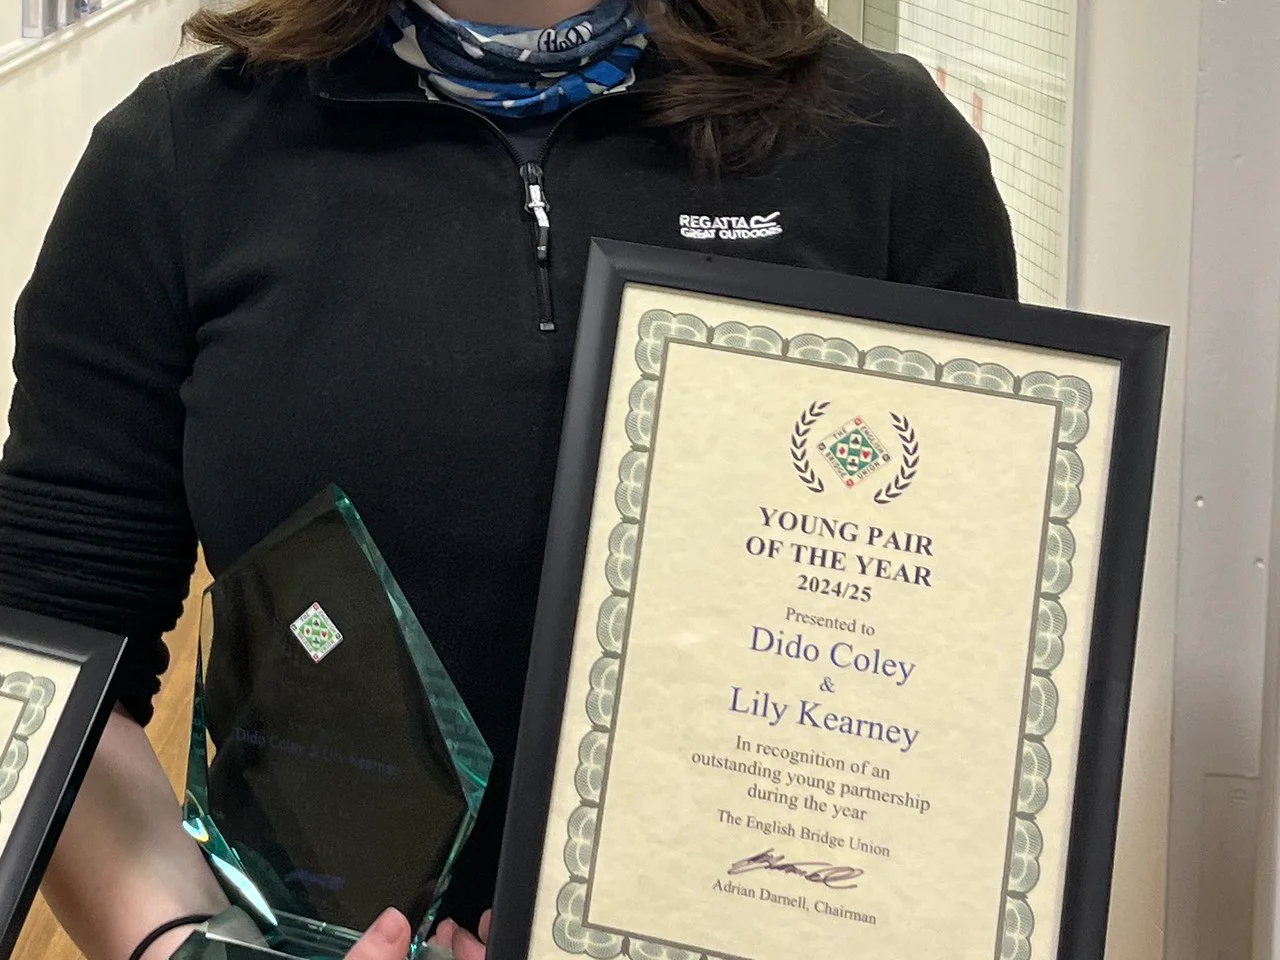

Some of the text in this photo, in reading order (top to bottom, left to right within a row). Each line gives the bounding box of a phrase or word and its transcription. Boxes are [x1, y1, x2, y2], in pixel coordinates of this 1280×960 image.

[679, 214, 750, 229] REGATTA
[680, 227, 716, 239] GREAT
[759, 506, 934, 557] YOUNG PAIR
[745, 535, 932, 588] OF THE YEAR
[797, 574, 872, 603] 2024/25
[785, 606, 876, 637] Presented to
[749, 625, 916, 687] Dido Coley
[819, 676, 835, 694] &
[728, 685, 920, 753] Lily Kearney
[735, 735, 891, 780] In recognition of an
[691, 751, 931, 815] outstanding young partnership
[747, 783, 868, 822] during the year
[717, 809, 891, 858] The English Bridge Union
[712, 878, 877, 925] Adrian Darnell, Chairman
